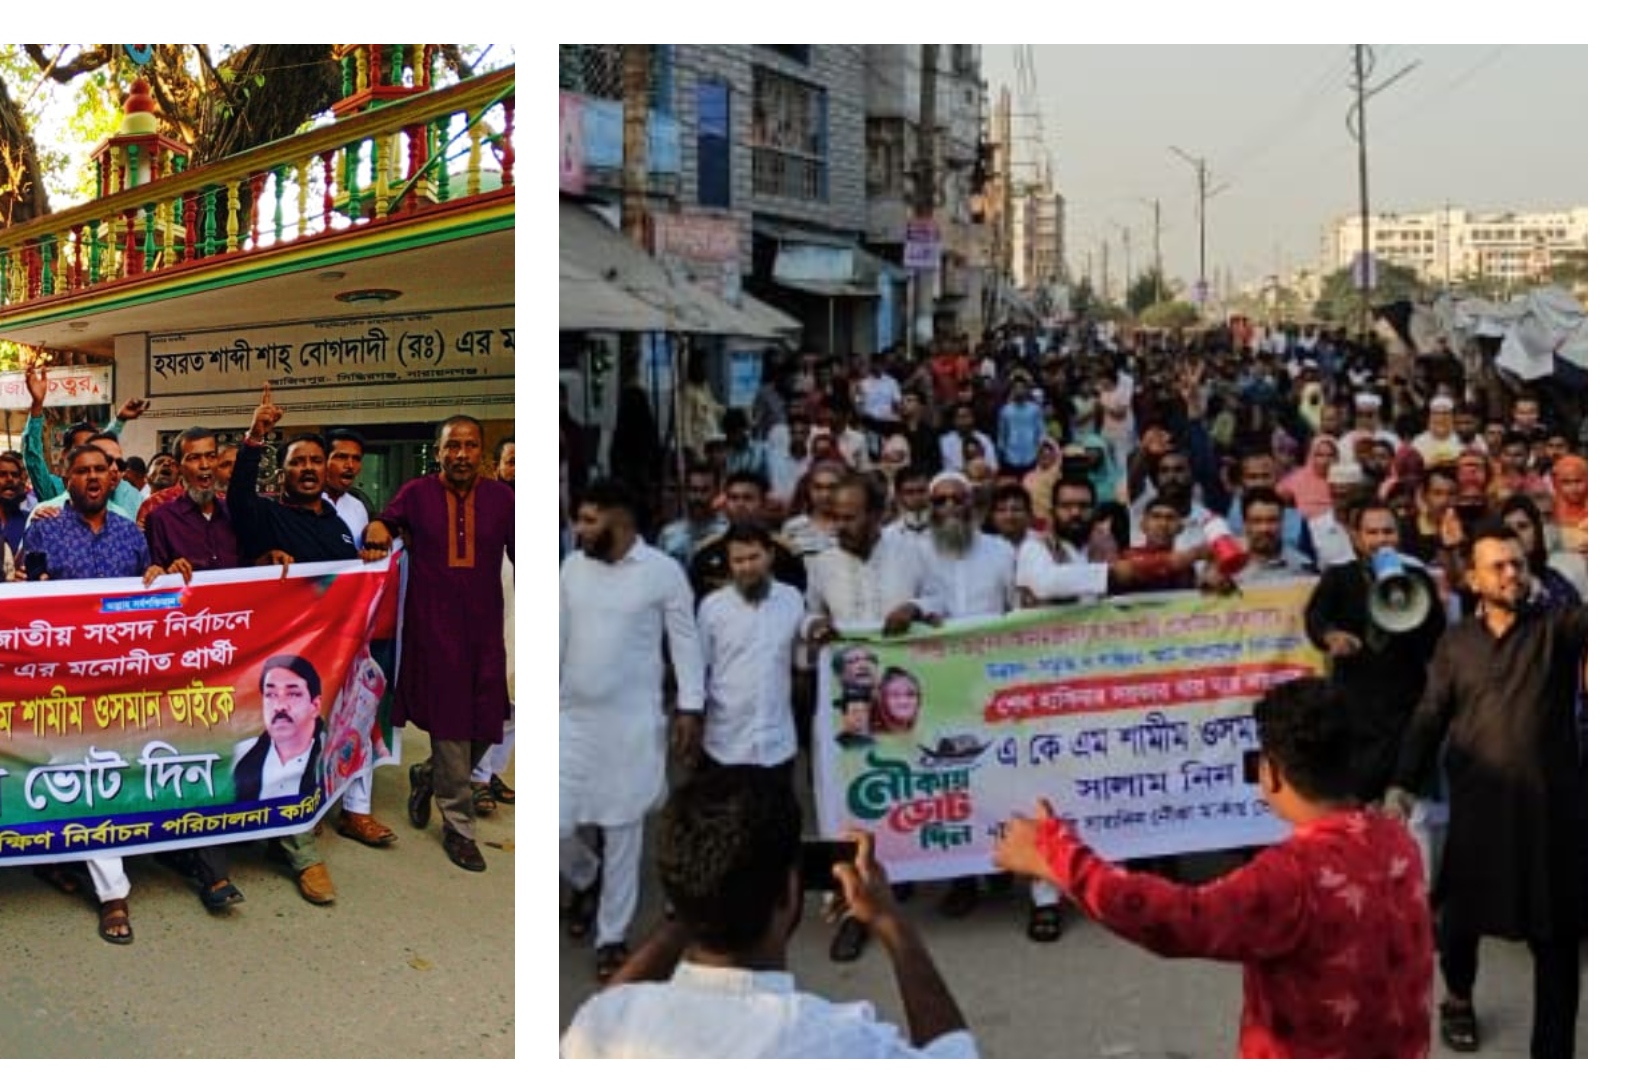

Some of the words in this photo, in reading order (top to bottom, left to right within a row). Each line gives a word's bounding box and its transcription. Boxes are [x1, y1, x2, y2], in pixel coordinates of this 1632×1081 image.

[153, 351, 206, 379] হযরত
[299, 327, 389, 367] বোগদাদী
[455, 330, 494, 357] এর
[83, 618, 157, 644] সংসদ
[164, 607, 254, 638] নির্বাচনে
[14, 661, 59, 679] এর
[67, 652, 174, 678] মনোনীত
[181, 638, 238, 669] প্রার্থী
[21, 685, 86, 738] শামীম
[92, 687, 162, 732] ওসমান
[167, 680, 237, 728] ভাইকে
[1119, 712, 1188, 756] শামীম
[24, 746, 130, 812] ভোট
[138, 740, 222, 801] দিন
[1075, 772, 1167, 801] সালাম
[1181, 761, 1237, 792] নিন
[63, 819, 154, 847] নির্বাচন
[161, 807, 273, 835] পরিচালনা
[888, 791, 973, 833] ভোট
[920, 822, 973, 850] দিন
